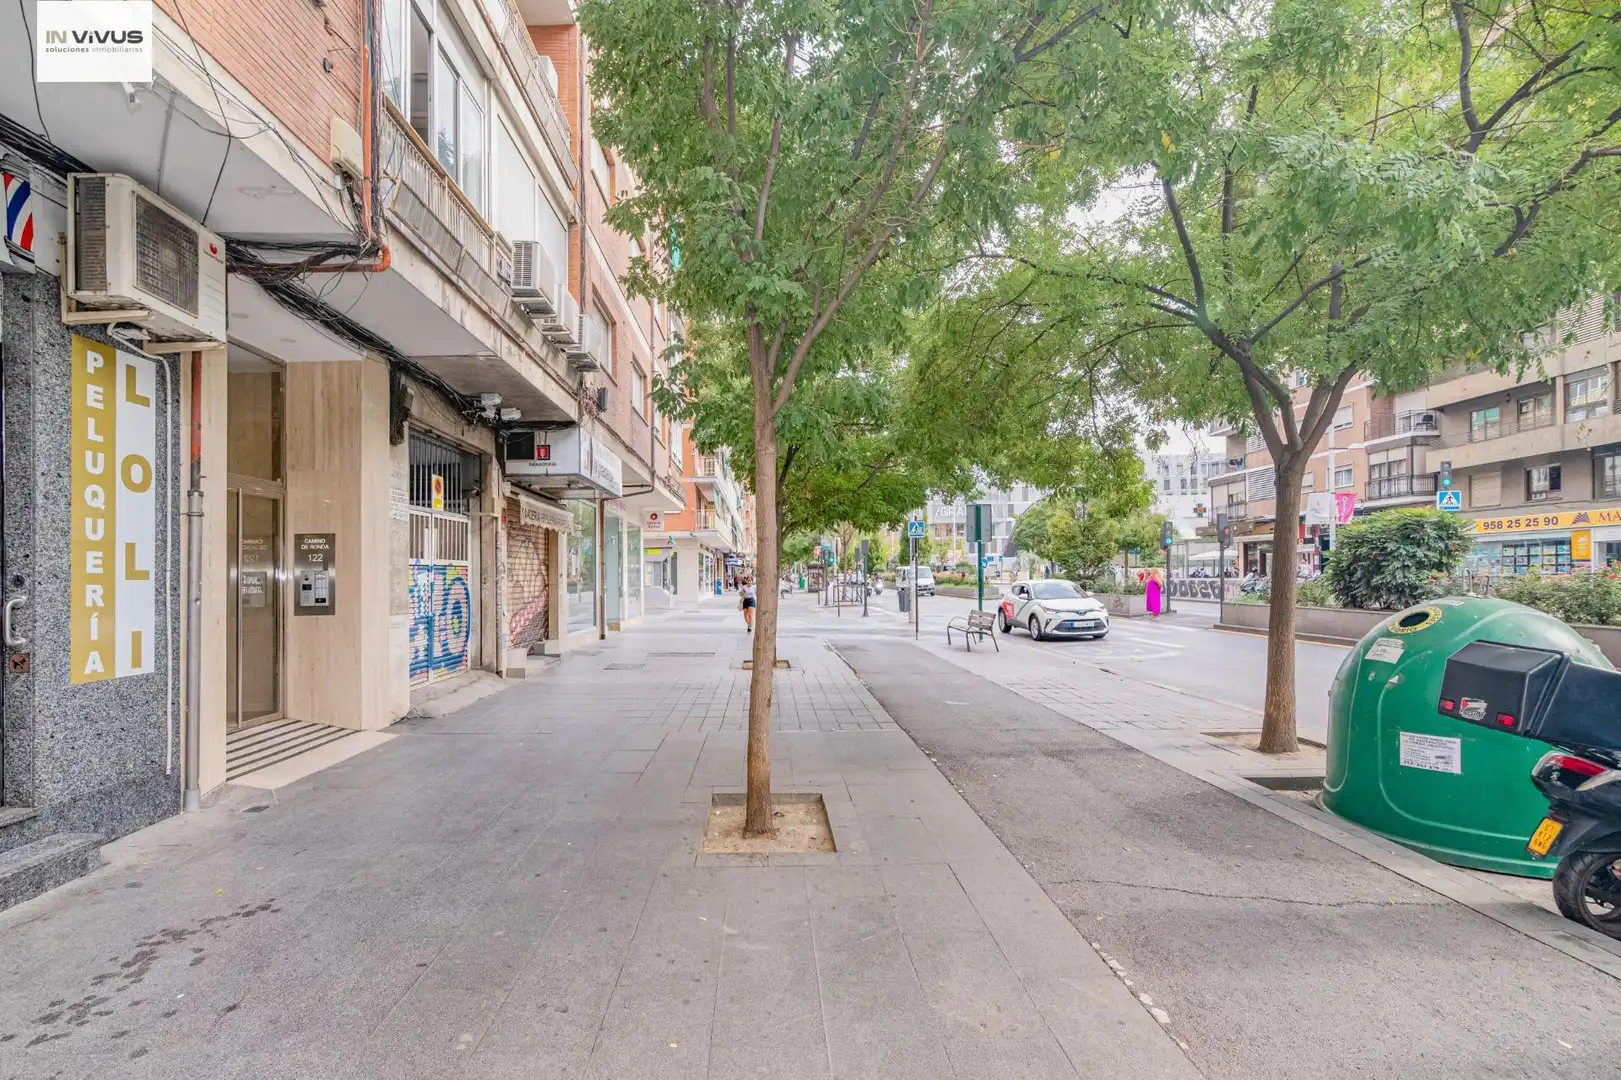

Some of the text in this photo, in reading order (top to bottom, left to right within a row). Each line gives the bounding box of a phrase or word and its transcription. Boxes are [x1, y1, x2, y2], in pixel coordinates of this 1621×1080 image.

[120, 363, 153, 669] LOLI
[1483, 520, 1503, 531] 958
[1507, 518, 1521, 529] 25
[1525, 517, 1539, 527] 25
[1543, 516, 1559, 526] 90
[308, 553, 323, 562] 122
